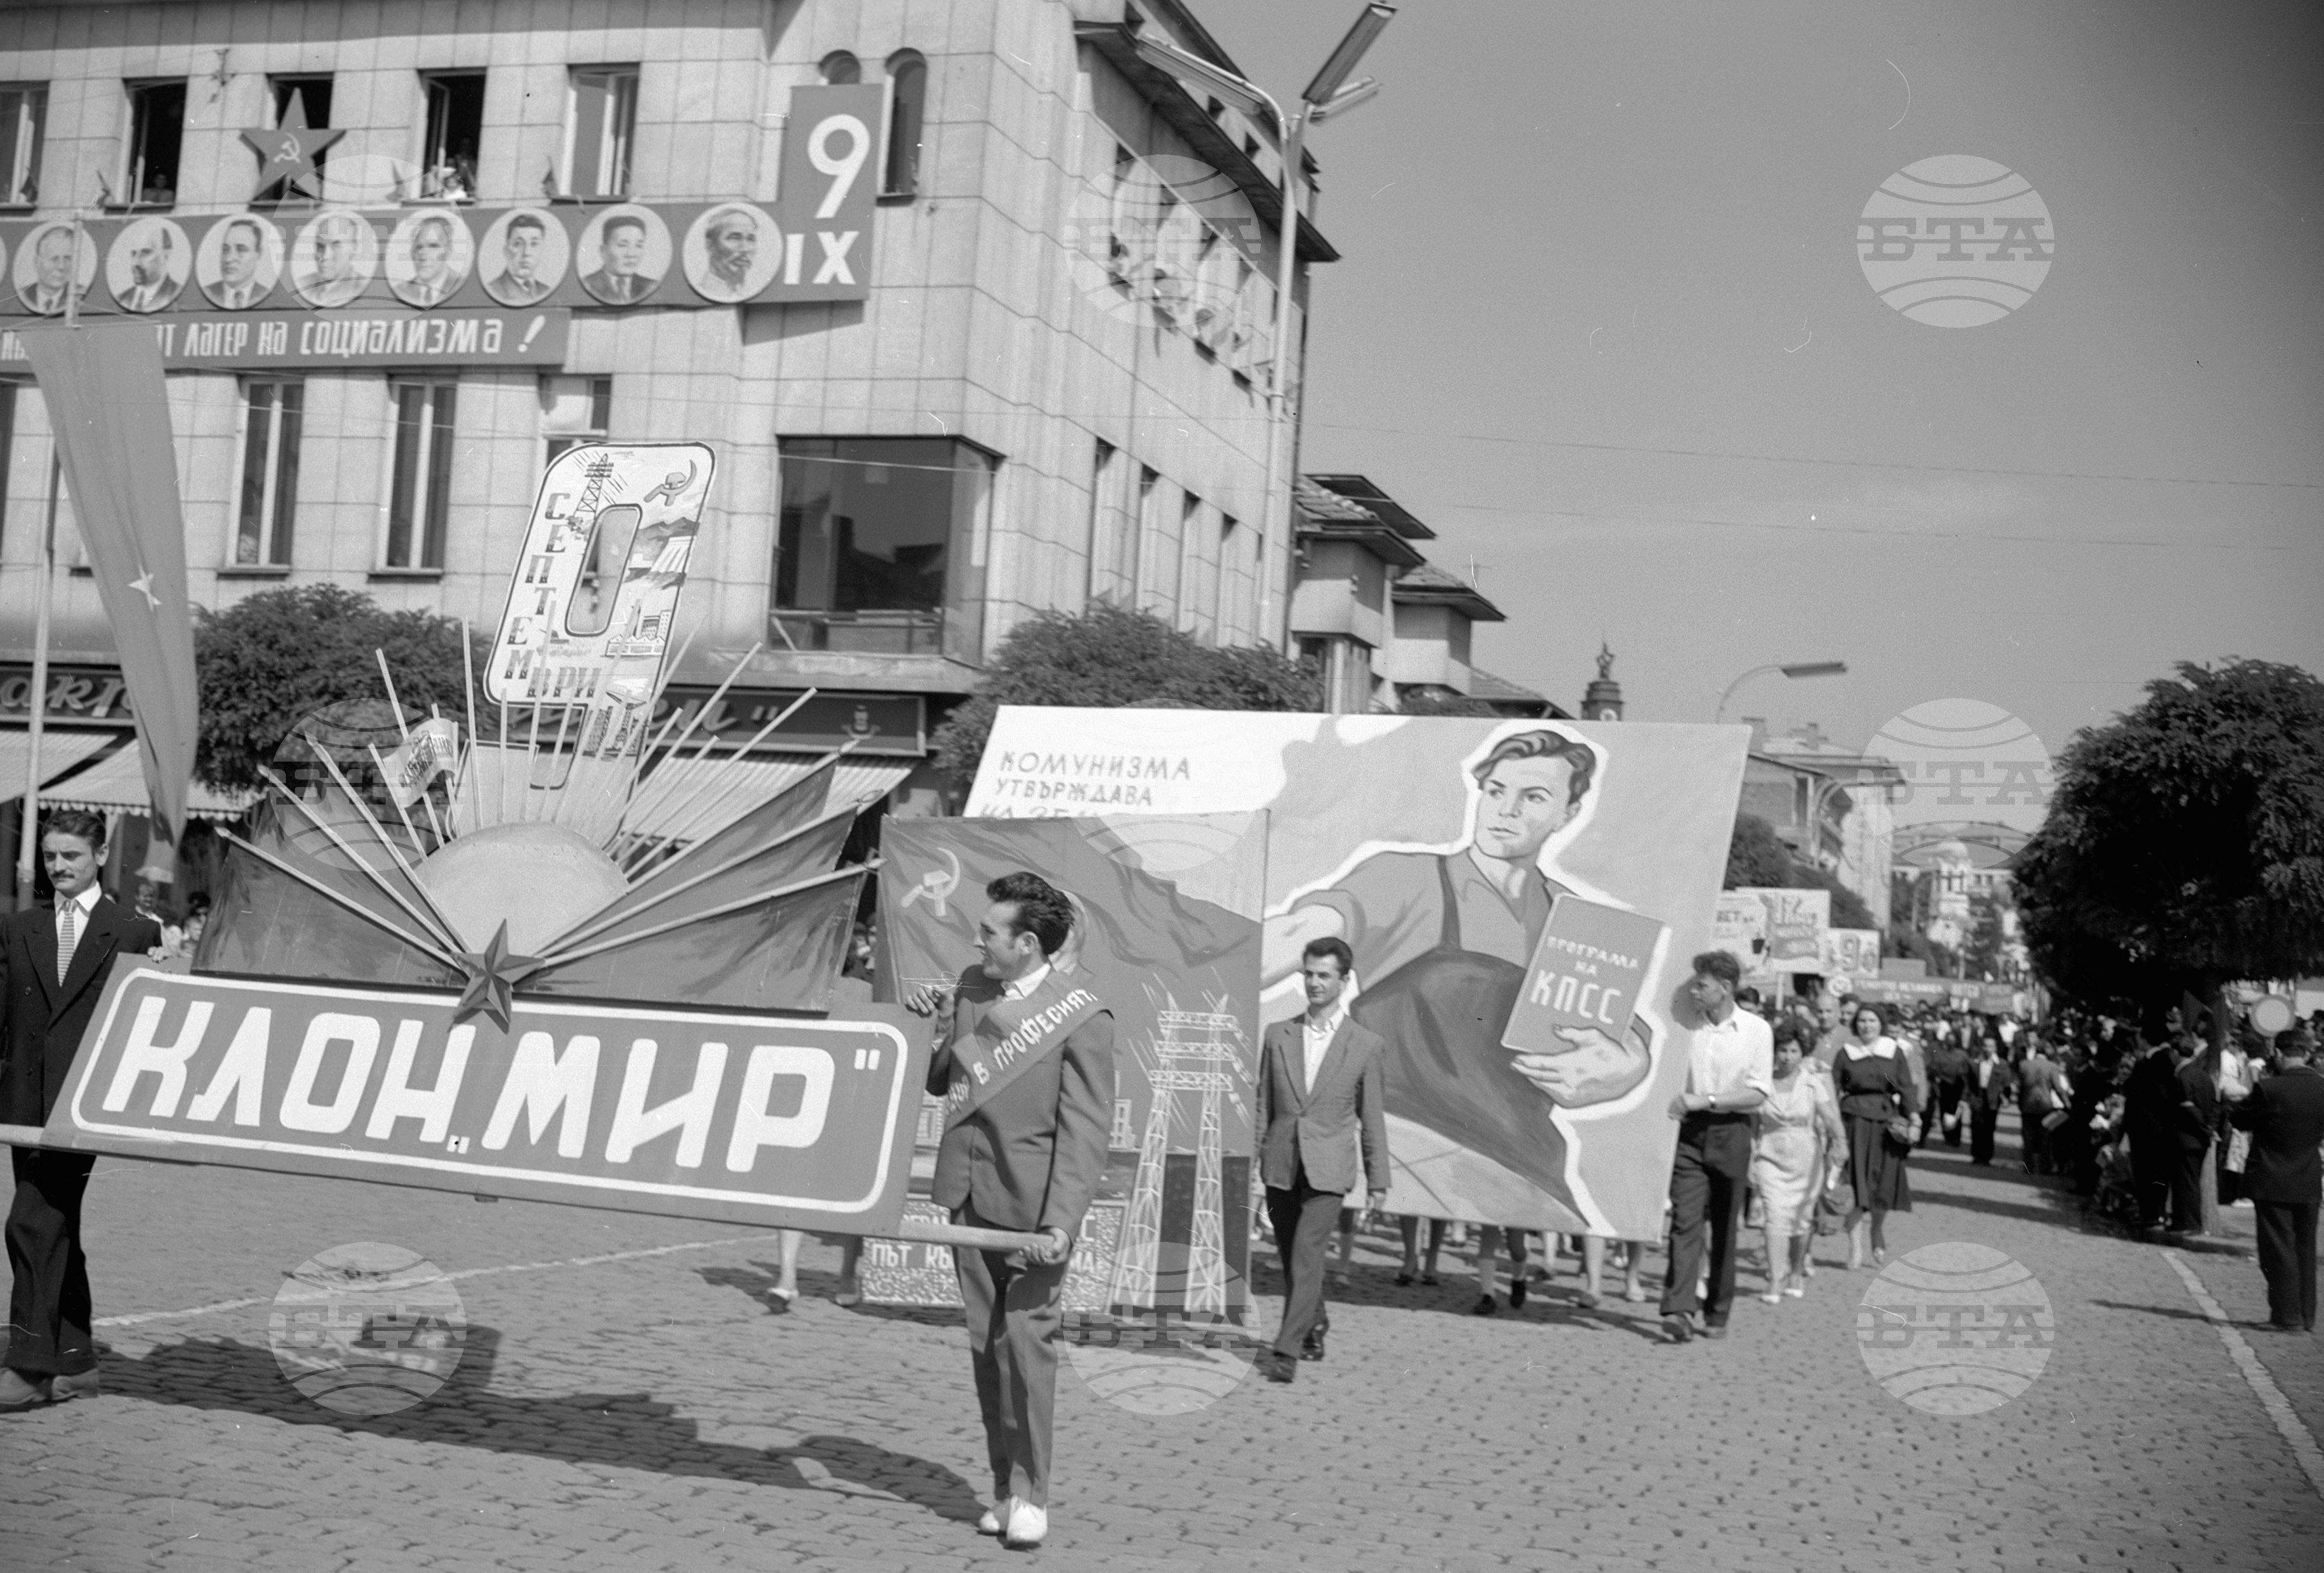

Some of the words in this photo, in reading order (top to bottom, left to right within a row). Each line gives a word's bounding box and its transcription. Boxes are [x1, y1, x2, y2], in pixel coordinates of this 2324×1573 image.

[808, 114, 870, 219] 9
[784, 231, 859, 285] IX
[996, 778, 1152, 806] УТВЪРЖДАВА
[1000, 752, 1190, 780] КОМУНИЗМА
[1529, 969, 1622, 1025] КПСС
[973, 1061, 990, 1085] В
[993, 989, 1103, 1071] ПРОФЕСИЯТ
[102, 995, 475, 1143] КЛОН
[926, 1243, 955, 1270] КЪ
